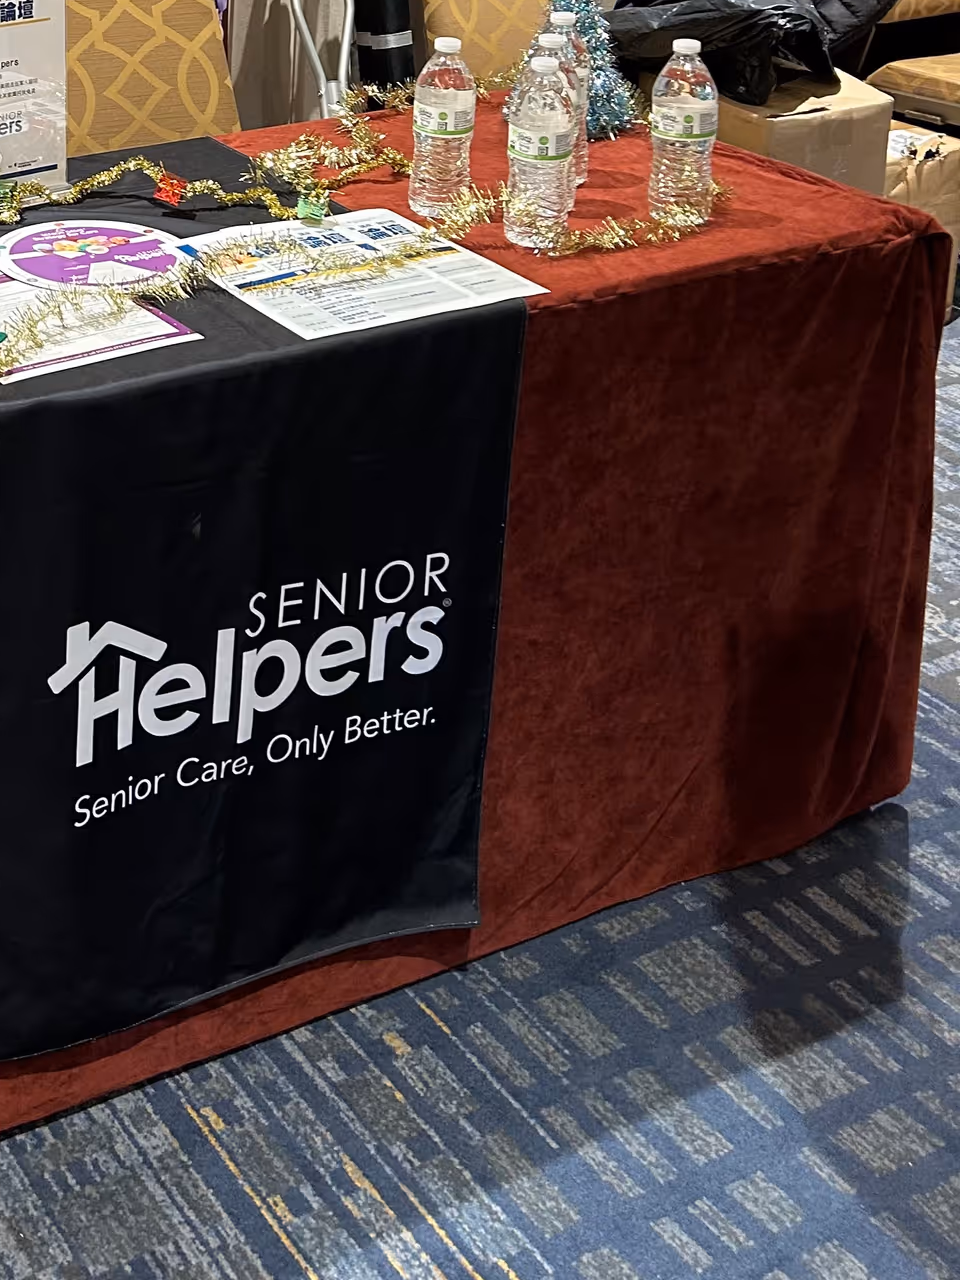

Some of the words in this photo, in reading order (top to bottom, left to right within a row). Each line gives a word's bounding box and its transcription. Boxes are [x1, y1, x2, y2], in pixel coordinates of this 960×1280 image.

[245, 552, 451, 638] SENIOR
[76, 606, 446, 768] Helpers
[73, 771, 166, 828] Senior
[176, 752, 255, 788] Care,
[266, 725, 335, 765] Only
[343, 706, 437, 745] Better.
